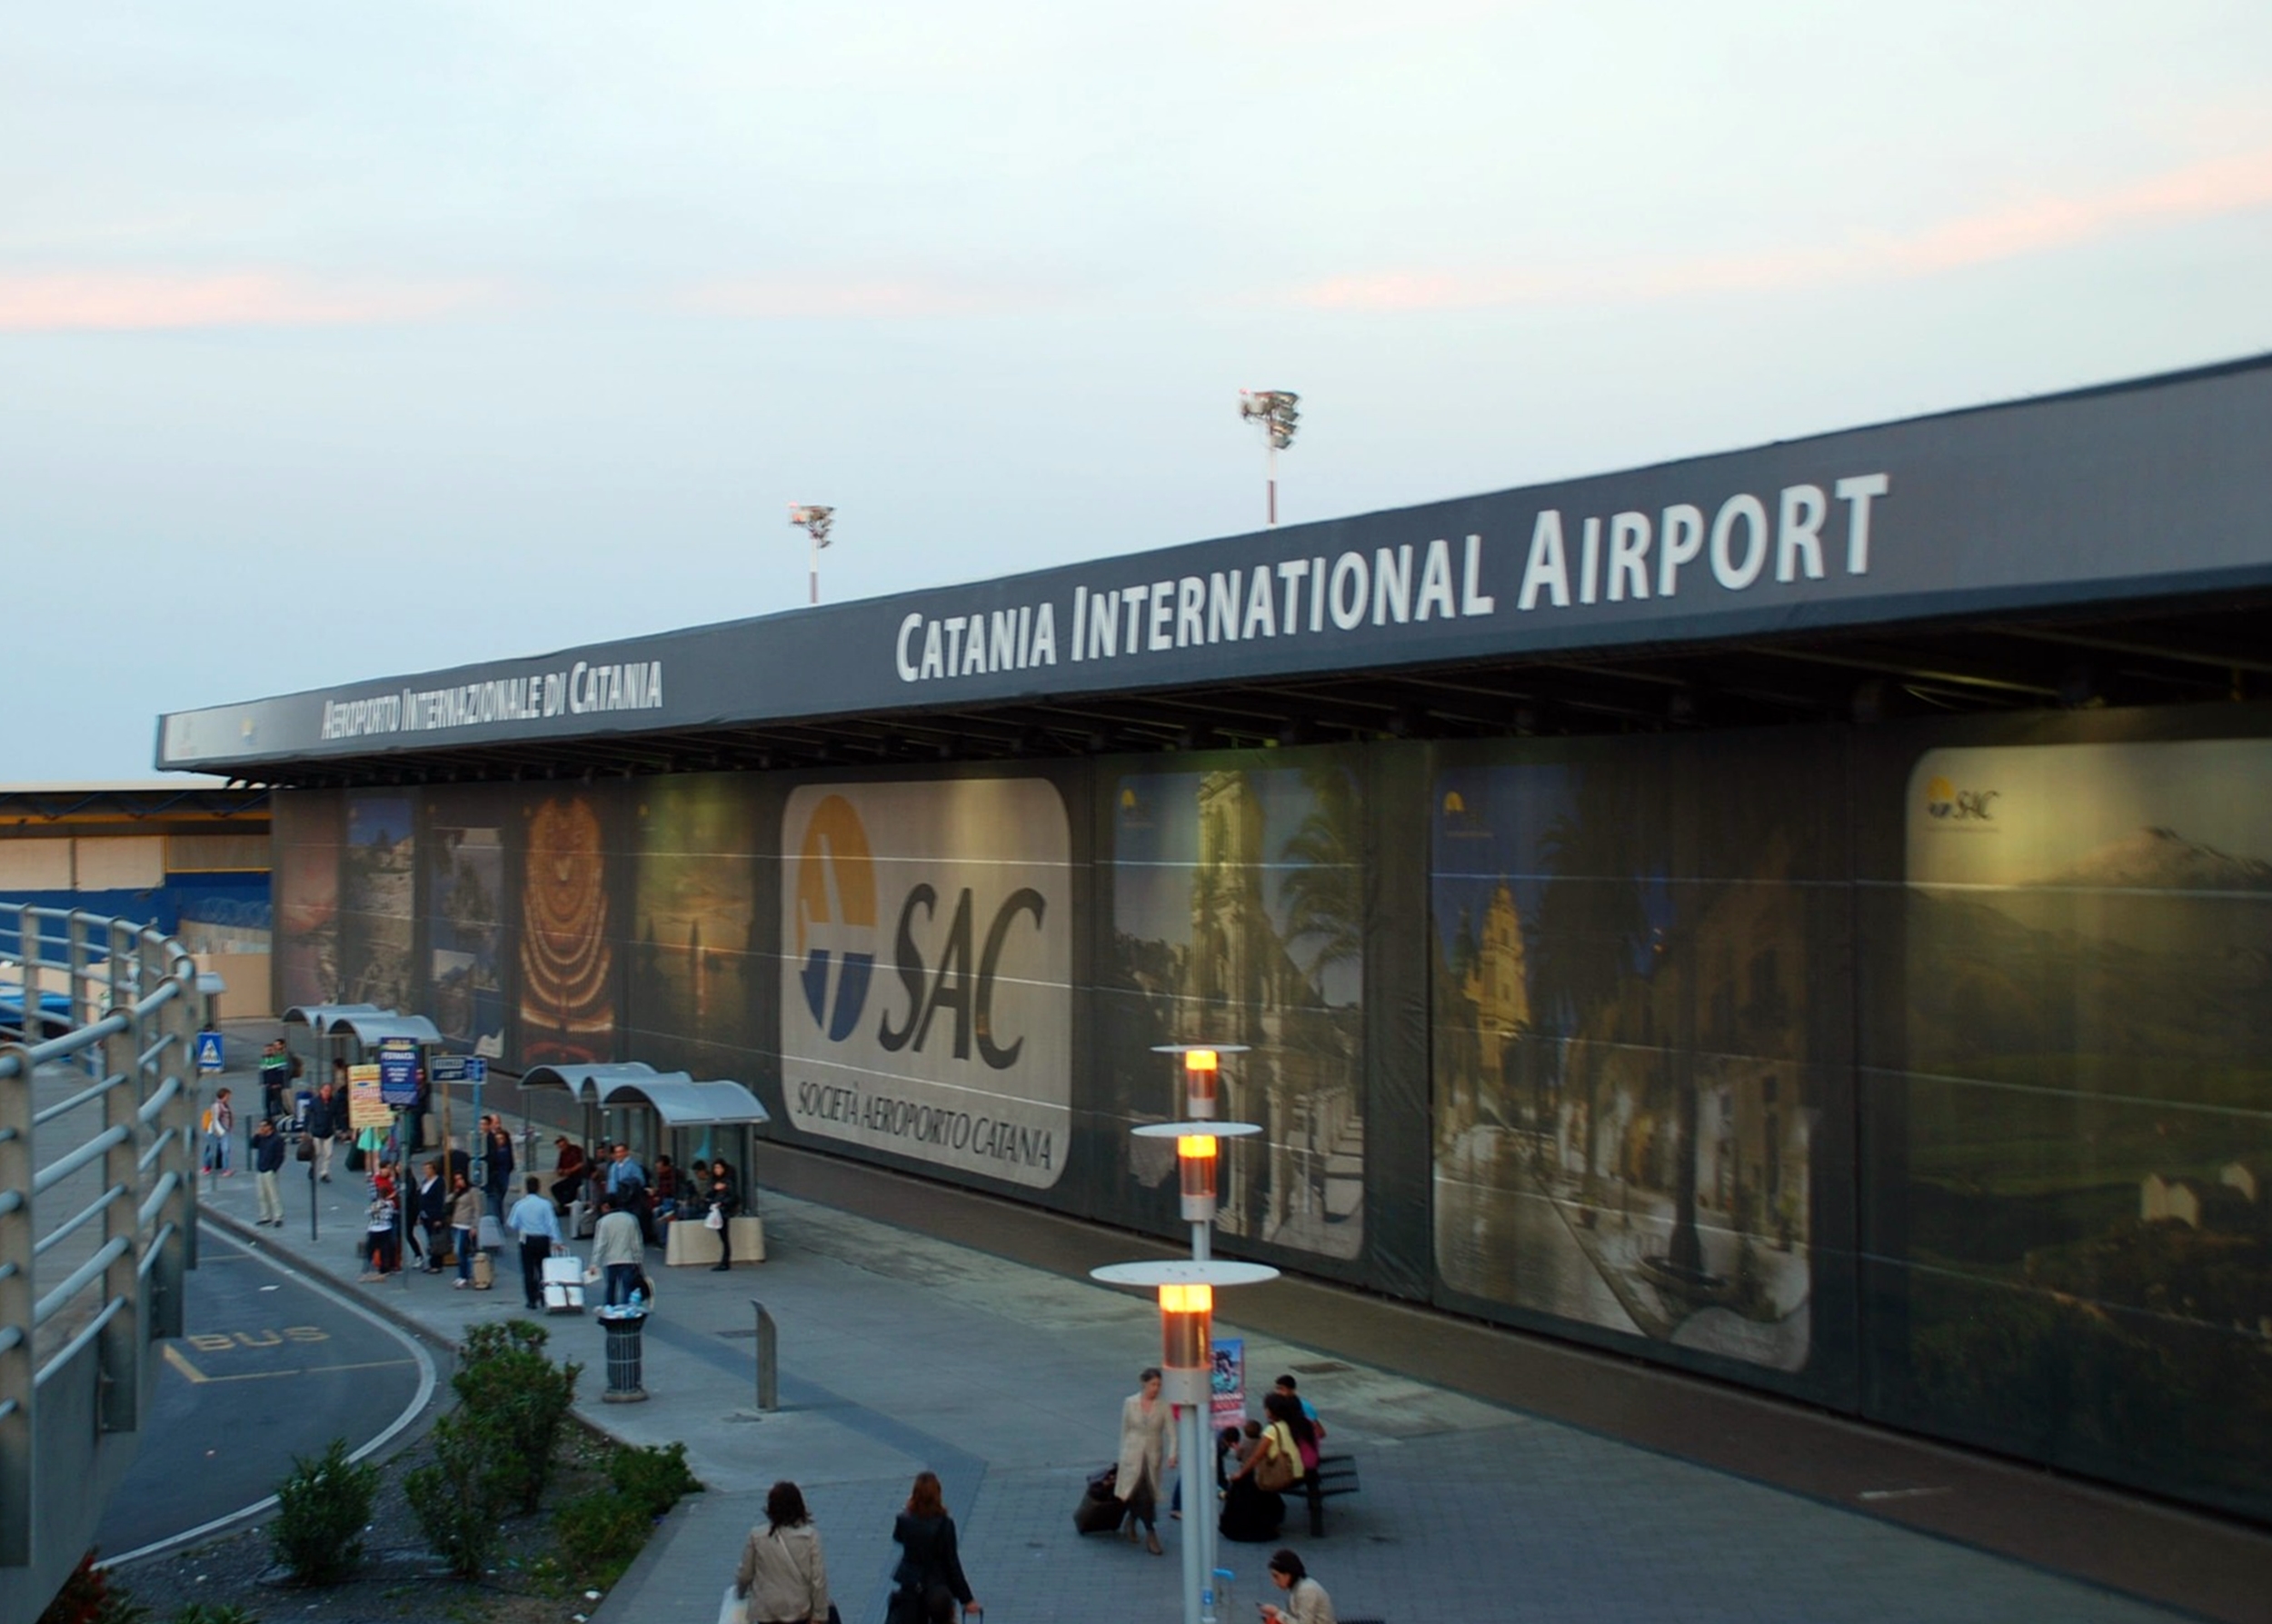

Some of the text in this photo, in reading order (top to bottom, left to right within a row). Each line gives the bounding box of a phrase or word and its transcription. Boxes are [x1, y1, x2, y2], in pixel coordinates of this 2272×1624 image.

[896, 473, 1888, 682] CATANIA INTERNATIONAL AIRPORT
[321, 661, 663, 740] AEROPORTO INTERNAZIONALE DI CATANIA
[878, 882, 1046, 1070] SAC
[861, 1093, 971, 1151] AEROPORTO
[972, 1116, 1051, 1171] CATANIA
[187, 1325, 331, 1351] BUS
